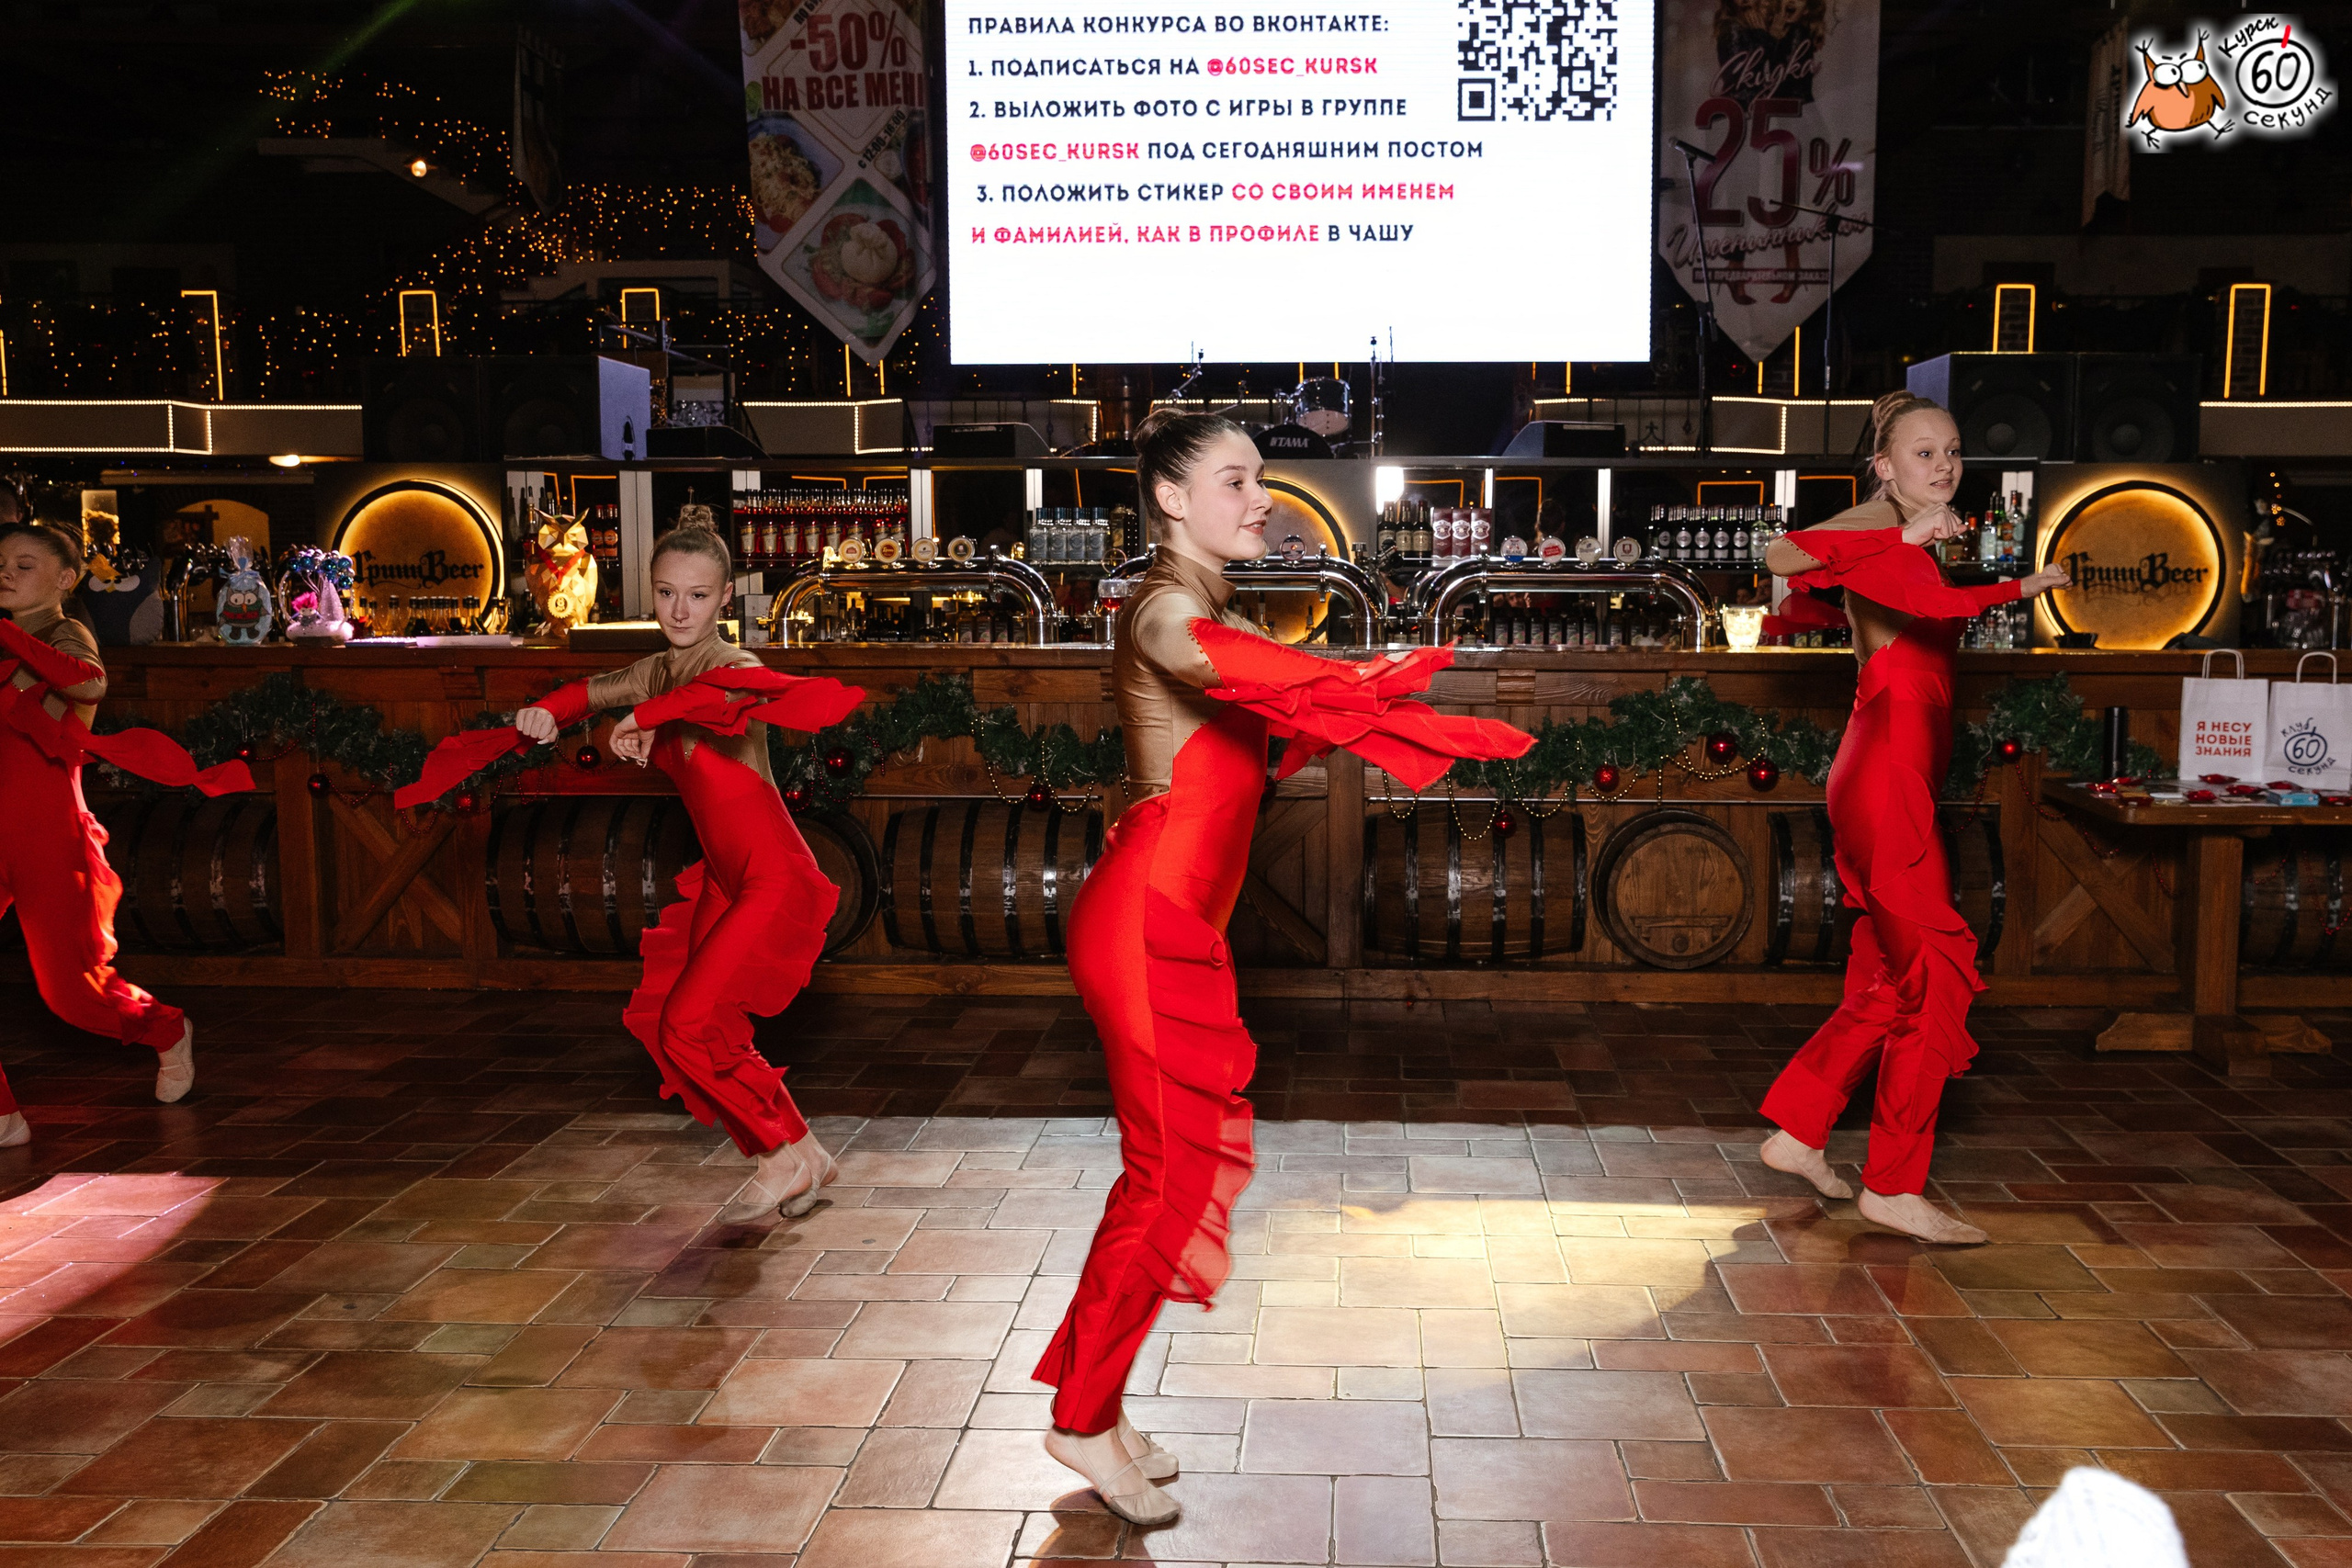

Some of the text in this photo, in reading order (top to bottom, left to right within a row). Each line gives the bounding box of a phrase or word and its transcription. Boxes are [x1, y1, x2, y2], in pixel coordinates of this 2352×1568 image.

[968, 15, 1389, 35] ПРАВИЛА КОНКУРСА ВО ВКОНТАКТЕ:
[790, 10, 907, 73] -50%
[967, 56, 1378, 78] 1. ПОДПИСАТЬСЯ НА @60SEC_KURSK
[762, 71, 924, 110] НА ВСЕ МЕН
[968, 98, 1407, 118] 2. ВЫЛОЖИТЬ ФОТО С ИГРЫ В ГРУППЕ
[863, 109, 906, 163] 12.00-16.00
[969, 141, 1483, 163] @60SEC_KURSK ПОД СЕГОДНЯШНИМ ПОСТОМ
[976, 182, 1454, 203] 3. ПОЛОЖИТЬ СТИКЕР СО СВОИМ ИМЕНЕМ
[971, 220, 1414, 244] И ФАМИЛИЕЙ, КАК В ПРОФИЛЕ В ЧАШУ
[1277, 436, 1310, 448] TAMA
[2197, 721, 2253, 732] Я НЕСУ
[2196, 735, 2252, 745] НОВЫЕ
[2293, 738, 2321, 760] 60
[2195, 747, 2252, 757] ЗНАНИЯ
[2288, 757, 2337, 775] секунд
